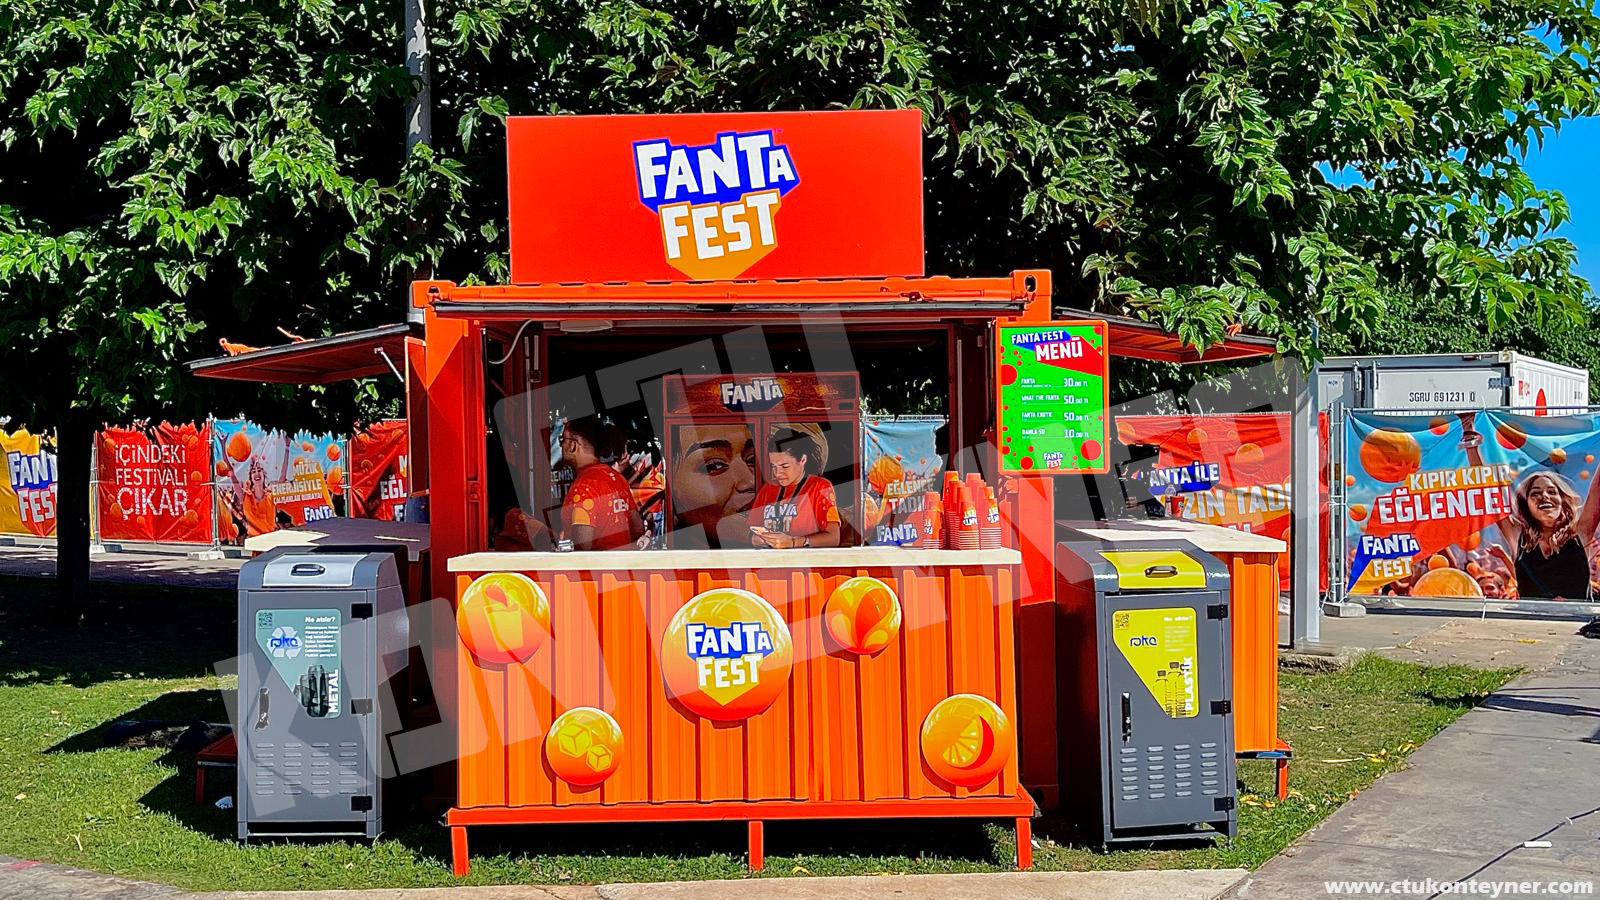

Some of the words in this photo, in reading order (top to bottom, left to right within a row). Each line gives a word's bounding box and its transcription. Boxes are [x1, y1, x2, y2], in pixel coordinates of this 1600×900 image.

[636, 135, 796, 199] FANTA
[662, 193, 778, 260] FEST
[1011, 332, 1040, 344] FANTA
[1042, 330, 1064, 341] FEST
[1035, 336, 1083, 362] MENÜ
[721, 379, 783, 405] FANTA
[1434, 391, 1465, 402] 691231
[1195, 461, 1220, 482] İLE
[1409, 469, 1459, 491] KIPIR
[1462, 465, 1513, 487] KIPIR
[117, 487, 188, 520] ÇIKAR
[1378, 484, 1512, 525] EĞLENCE!
[876, 524, 918, 543] FANTA
[1362, 533, 1420, 556] FANTA
[1373, 556, 1413, 578] FEST
[686, 622, 773, 655] FANTA
[696, 653, 762, 688] FEST
[328, 668, 339, 713] METAL
